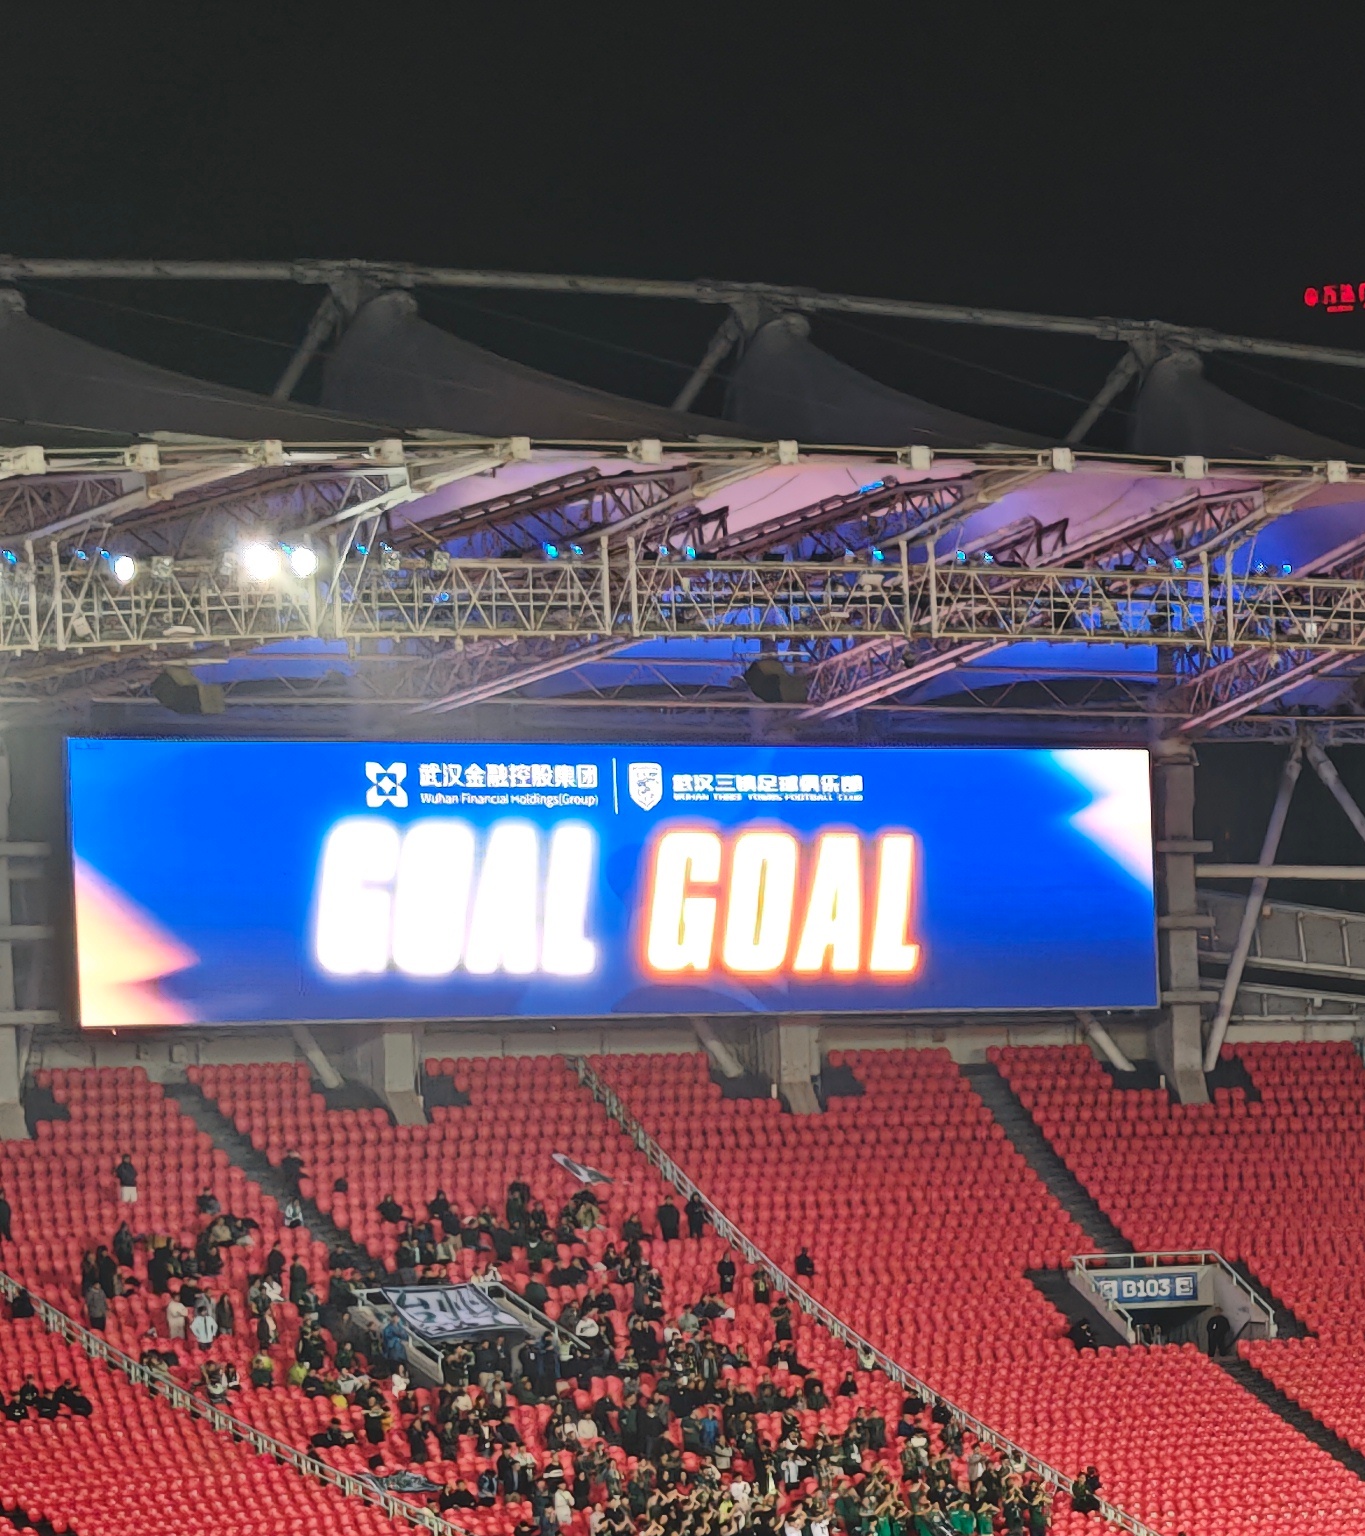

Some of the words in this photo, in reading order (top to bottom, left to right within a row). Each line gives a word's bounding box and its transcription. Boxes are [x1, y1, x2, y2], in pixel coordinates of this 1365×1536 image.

[418, 762, 598, 788] 武汉金融控股集团
[419, 792, 460, 804] Wuhan
[461, 792, 509, 805] Financial
[316, 820, 598, 978] GOAL
[645, 828, 921, 976] GOAL
[1121, 1278, 1171, 1298] B103
